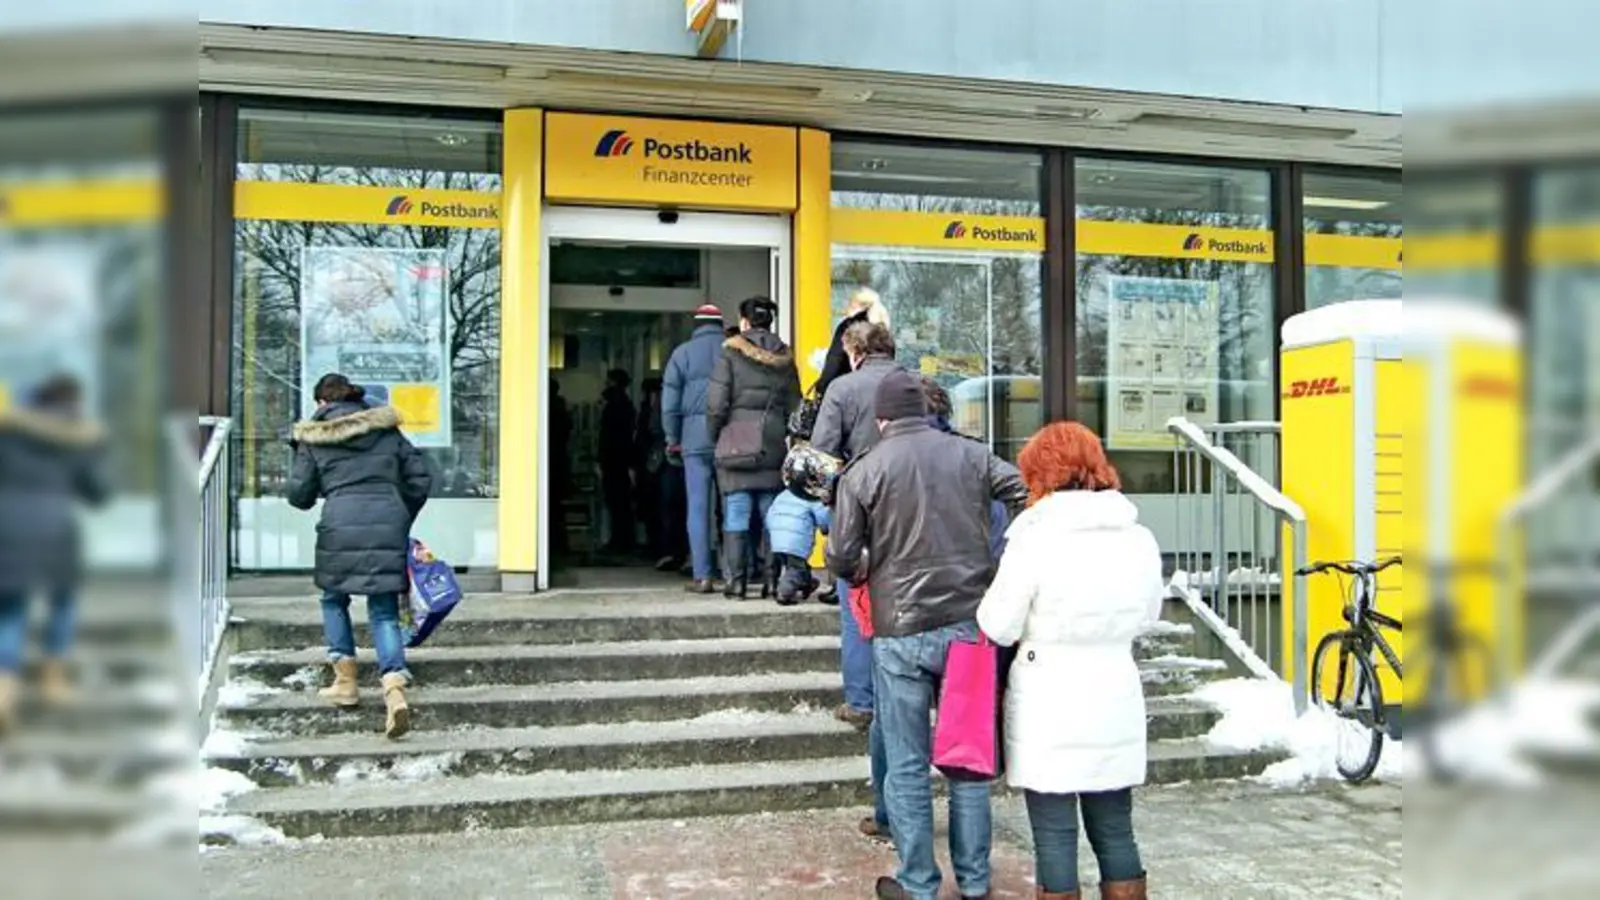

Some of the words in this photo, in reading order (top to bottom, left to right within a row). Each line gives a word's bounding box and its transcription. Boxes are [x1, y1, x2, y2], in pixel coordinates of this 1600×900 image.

[644, 138, 752, 162] Postbank
[643, 167, 752, 187] Finanzcenter
[421, 202, 498, 218] Postbank
[972, 227, 1037, 242] Postbank
[1208, 239, 1266, 254] Postbank
[1290, 377, 1340, 398] DHL
